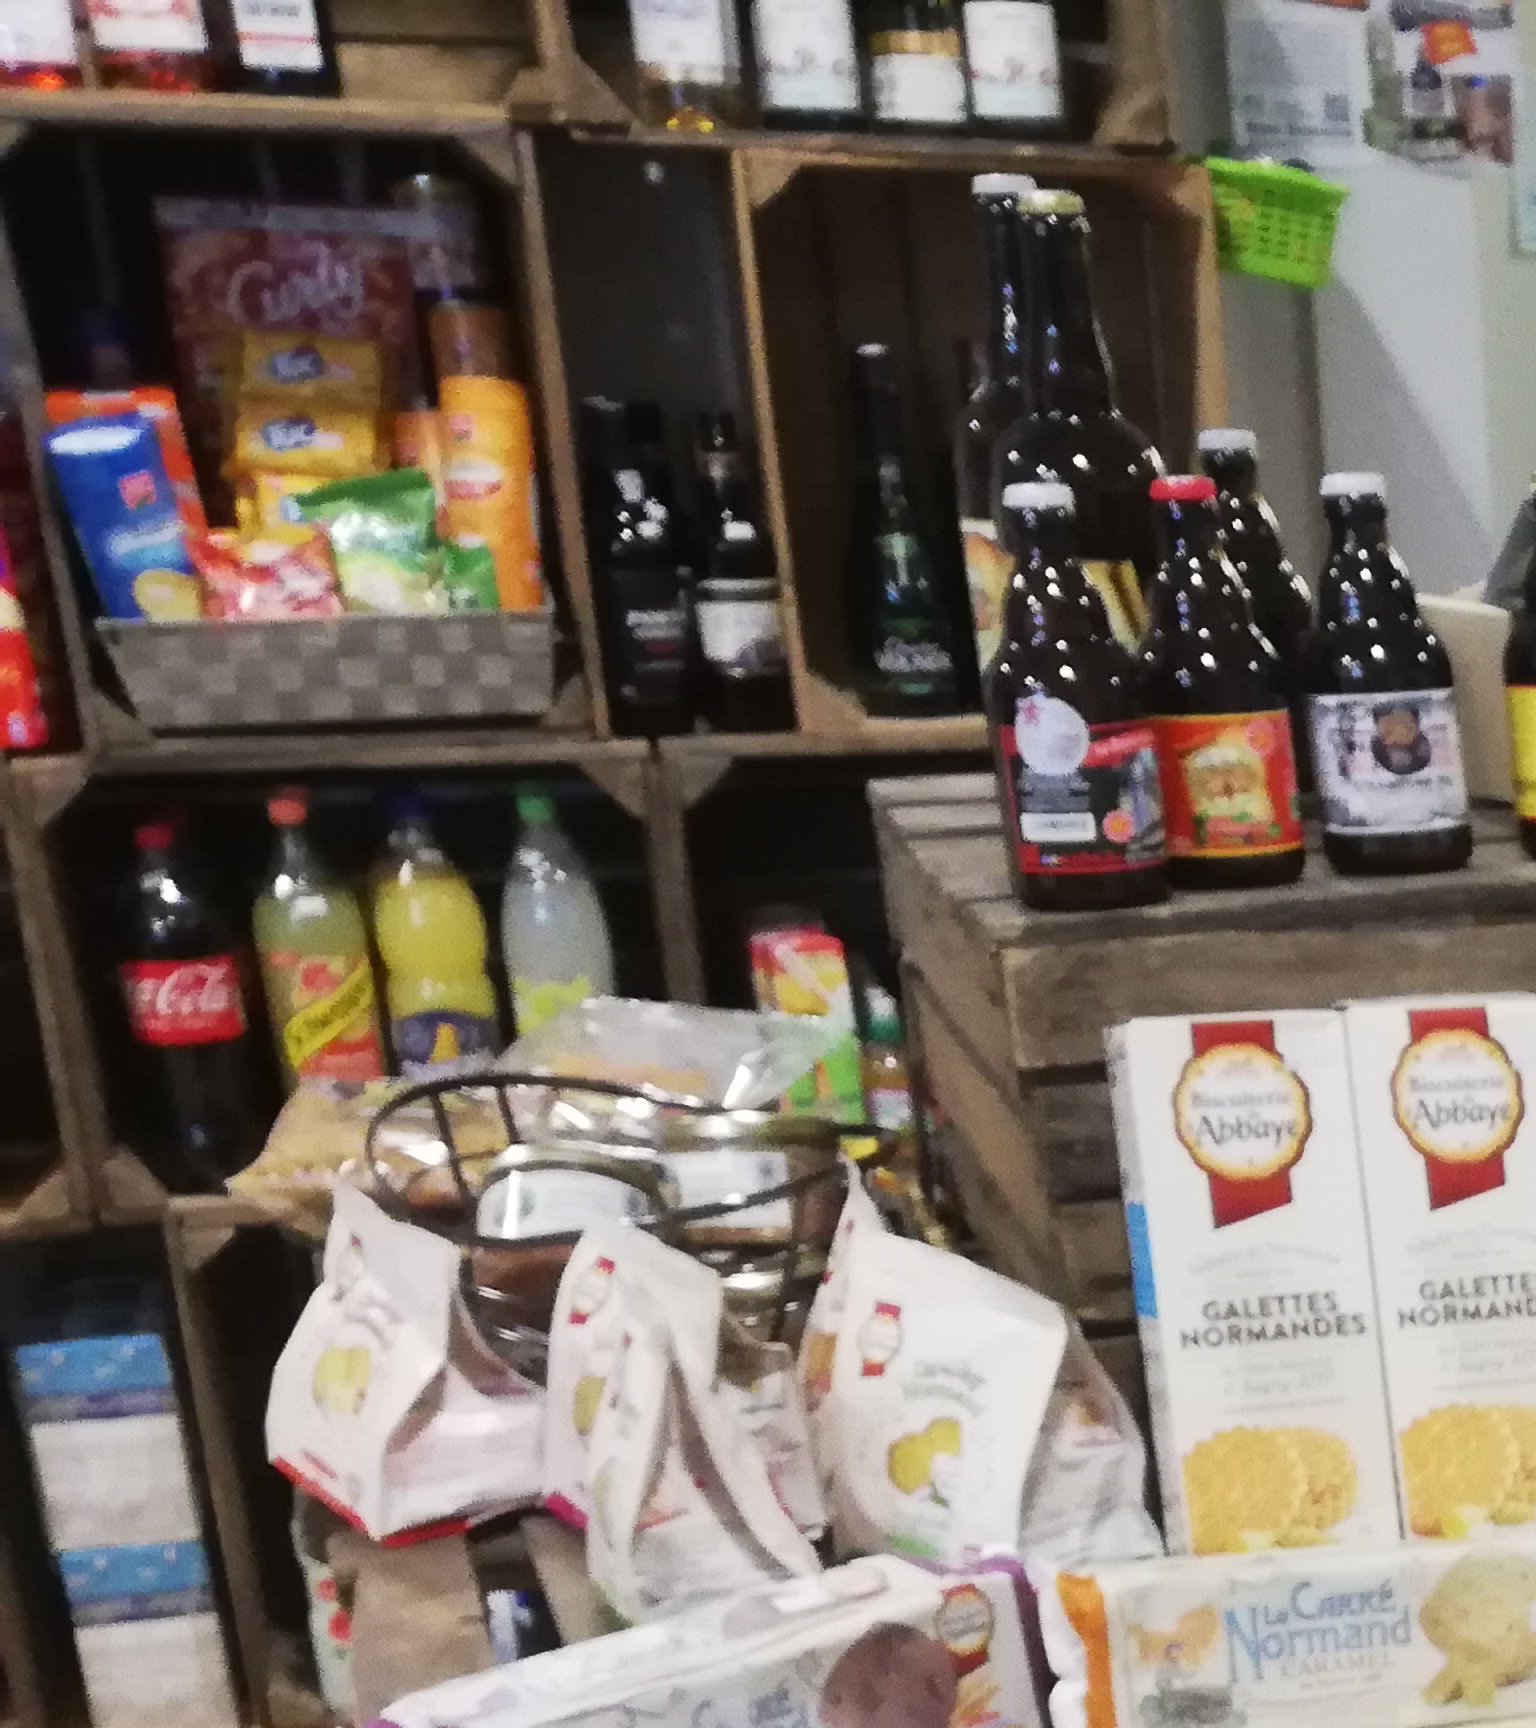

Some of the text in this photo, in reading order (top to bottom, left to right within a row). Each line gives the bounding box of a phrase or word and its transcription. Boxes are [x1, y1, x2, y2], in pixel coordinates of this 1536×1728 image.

[1202, 1290, 1337, 1321] GALETTES
[1180, 1313, 1366, 1350] NORMANDES
[1223, 1604, 1412, 1684] Normand
